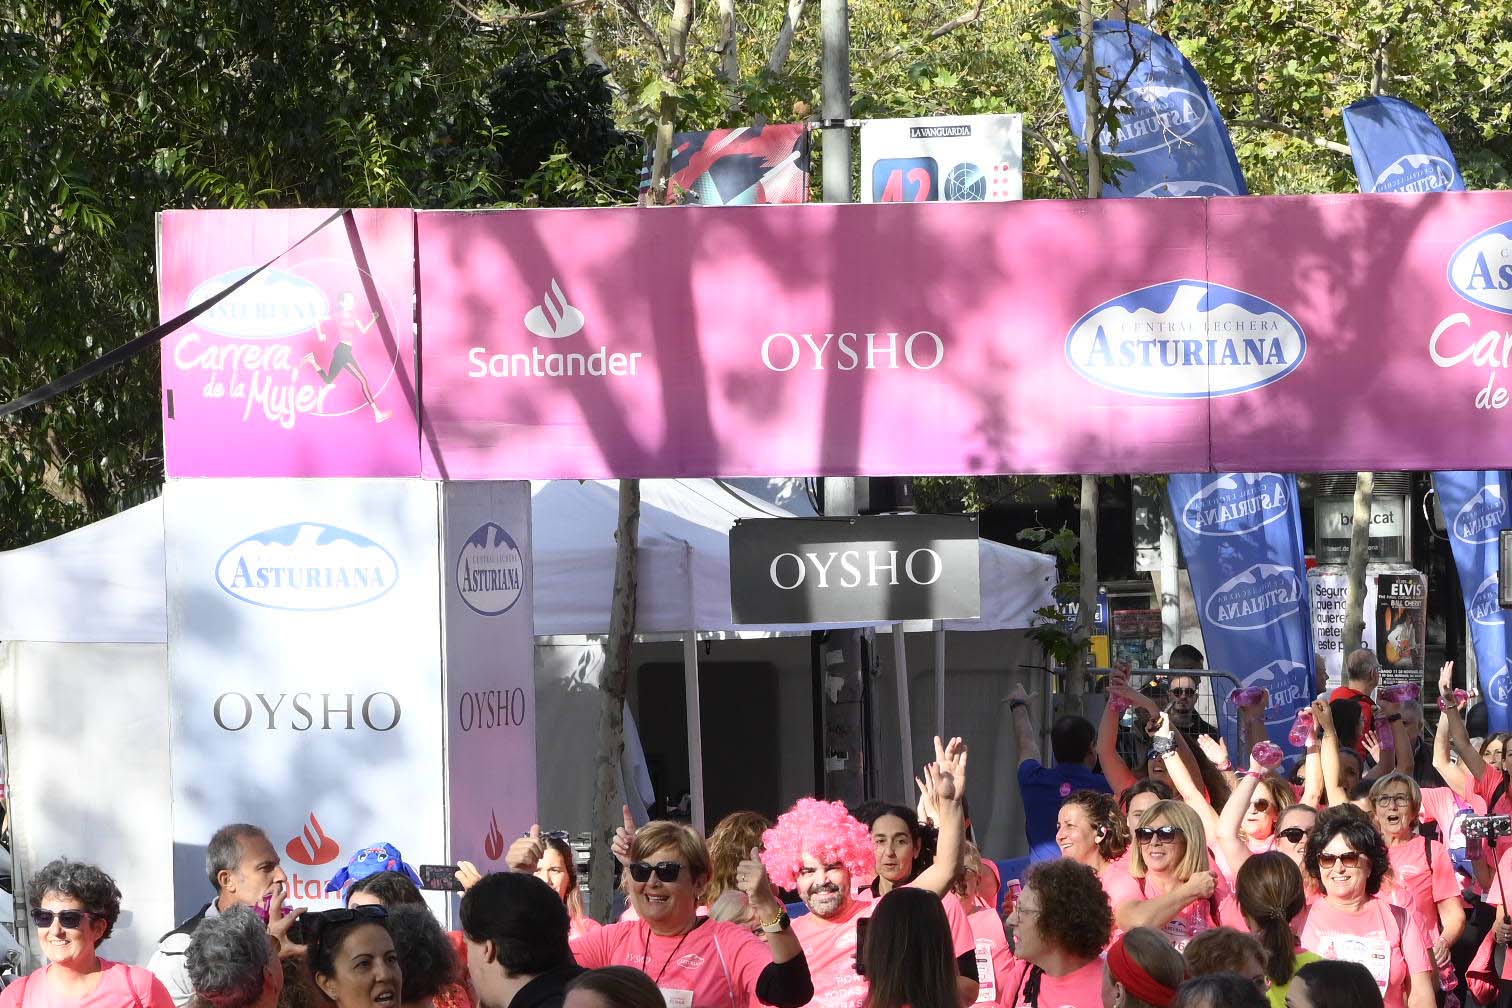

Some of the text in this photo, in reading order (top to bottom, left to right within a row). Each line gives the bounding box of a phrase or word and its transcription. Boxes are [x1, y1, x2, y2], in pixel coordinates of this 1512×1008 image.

[911, 126, 970, 137] LA VANGUARDIA
[881, 168, 931, 202] 42
[173, 333, 293, 372] Carrera
[468, 347, 642, 378] Santander
[761, 331, 944, 371] OYSHO
[1087, 325, 1287, 367] ASTURIANA
[204, 364, 336, 429] de la Mujer
[1475, 370, 1509, 410] de
[230, 555, 386, 589] ASTURIANA
[462, 564, 520, 593] ASTURIANA
[769, 548, 942, 589] OYSHO
[1317, 601, 1333, 612] que
[1391, 583, 1422, 596] ELVIS
[1318, 640, 1336, 650] este
[213, 692, 401, 731] OYSHO
[459, 687, 525, 732] OYSHO
